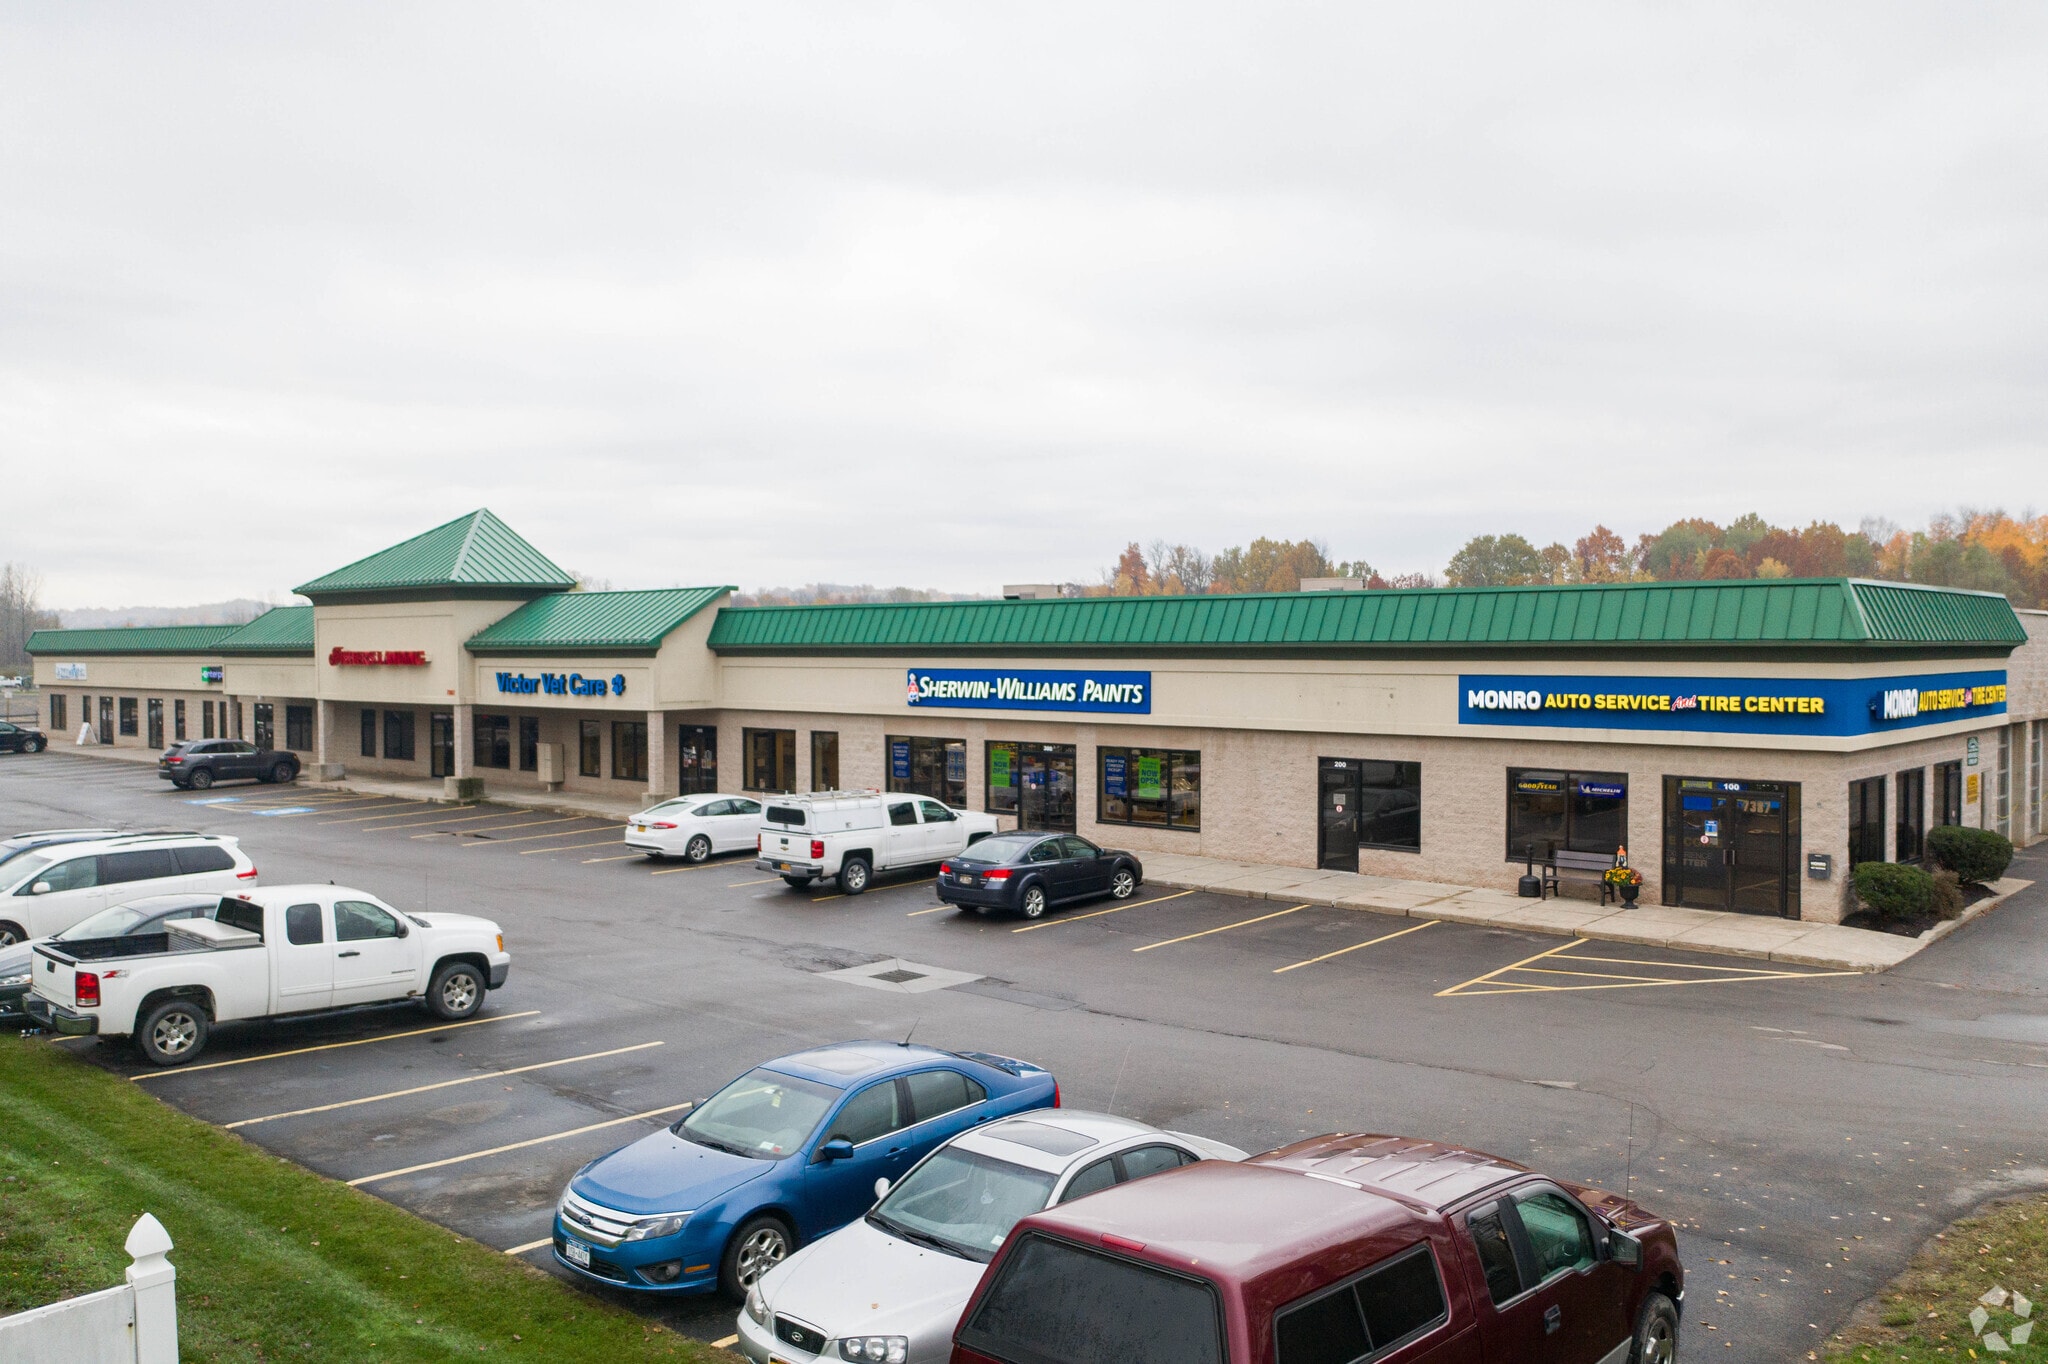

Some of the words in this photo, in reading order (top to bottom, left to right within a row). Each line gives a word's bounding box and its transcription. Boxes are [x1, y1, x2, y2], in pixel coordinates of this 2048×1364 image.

[496, 672, 540, 694] Victor
[541, 673, 567, 695] Vet
[569, 673, 608, 697] Care
[919, 676, 1077, 702] SHERWIN-WILLIAMS
[1082, 679, 1144, 704] PAINTS
[1468, 690, 1541, 710] MONRO
[1544, 693, 1592, 709] AUTO
[1594, 694, 1671, 711] SERVICE
[1697, 696, 1741, 712] TIRE
[1744, 697, 1825, 713] CENTER
[1885, 690, 1918, 719] MONRO
[1919, 690, 1937, 711] AUTO
[1938, 688, 1966, 710] SERVICE
[1972, 686, 1985, 705] TIRE
[1985, 684, 2006, 704] CENTER
[1140, 777, 1159, 785] OPEN
[1518, 782, 1557, 790] GOODYEAR
[1723, 782, 1740, 791] 100
[1743, 800, 1771, 814] 7387
